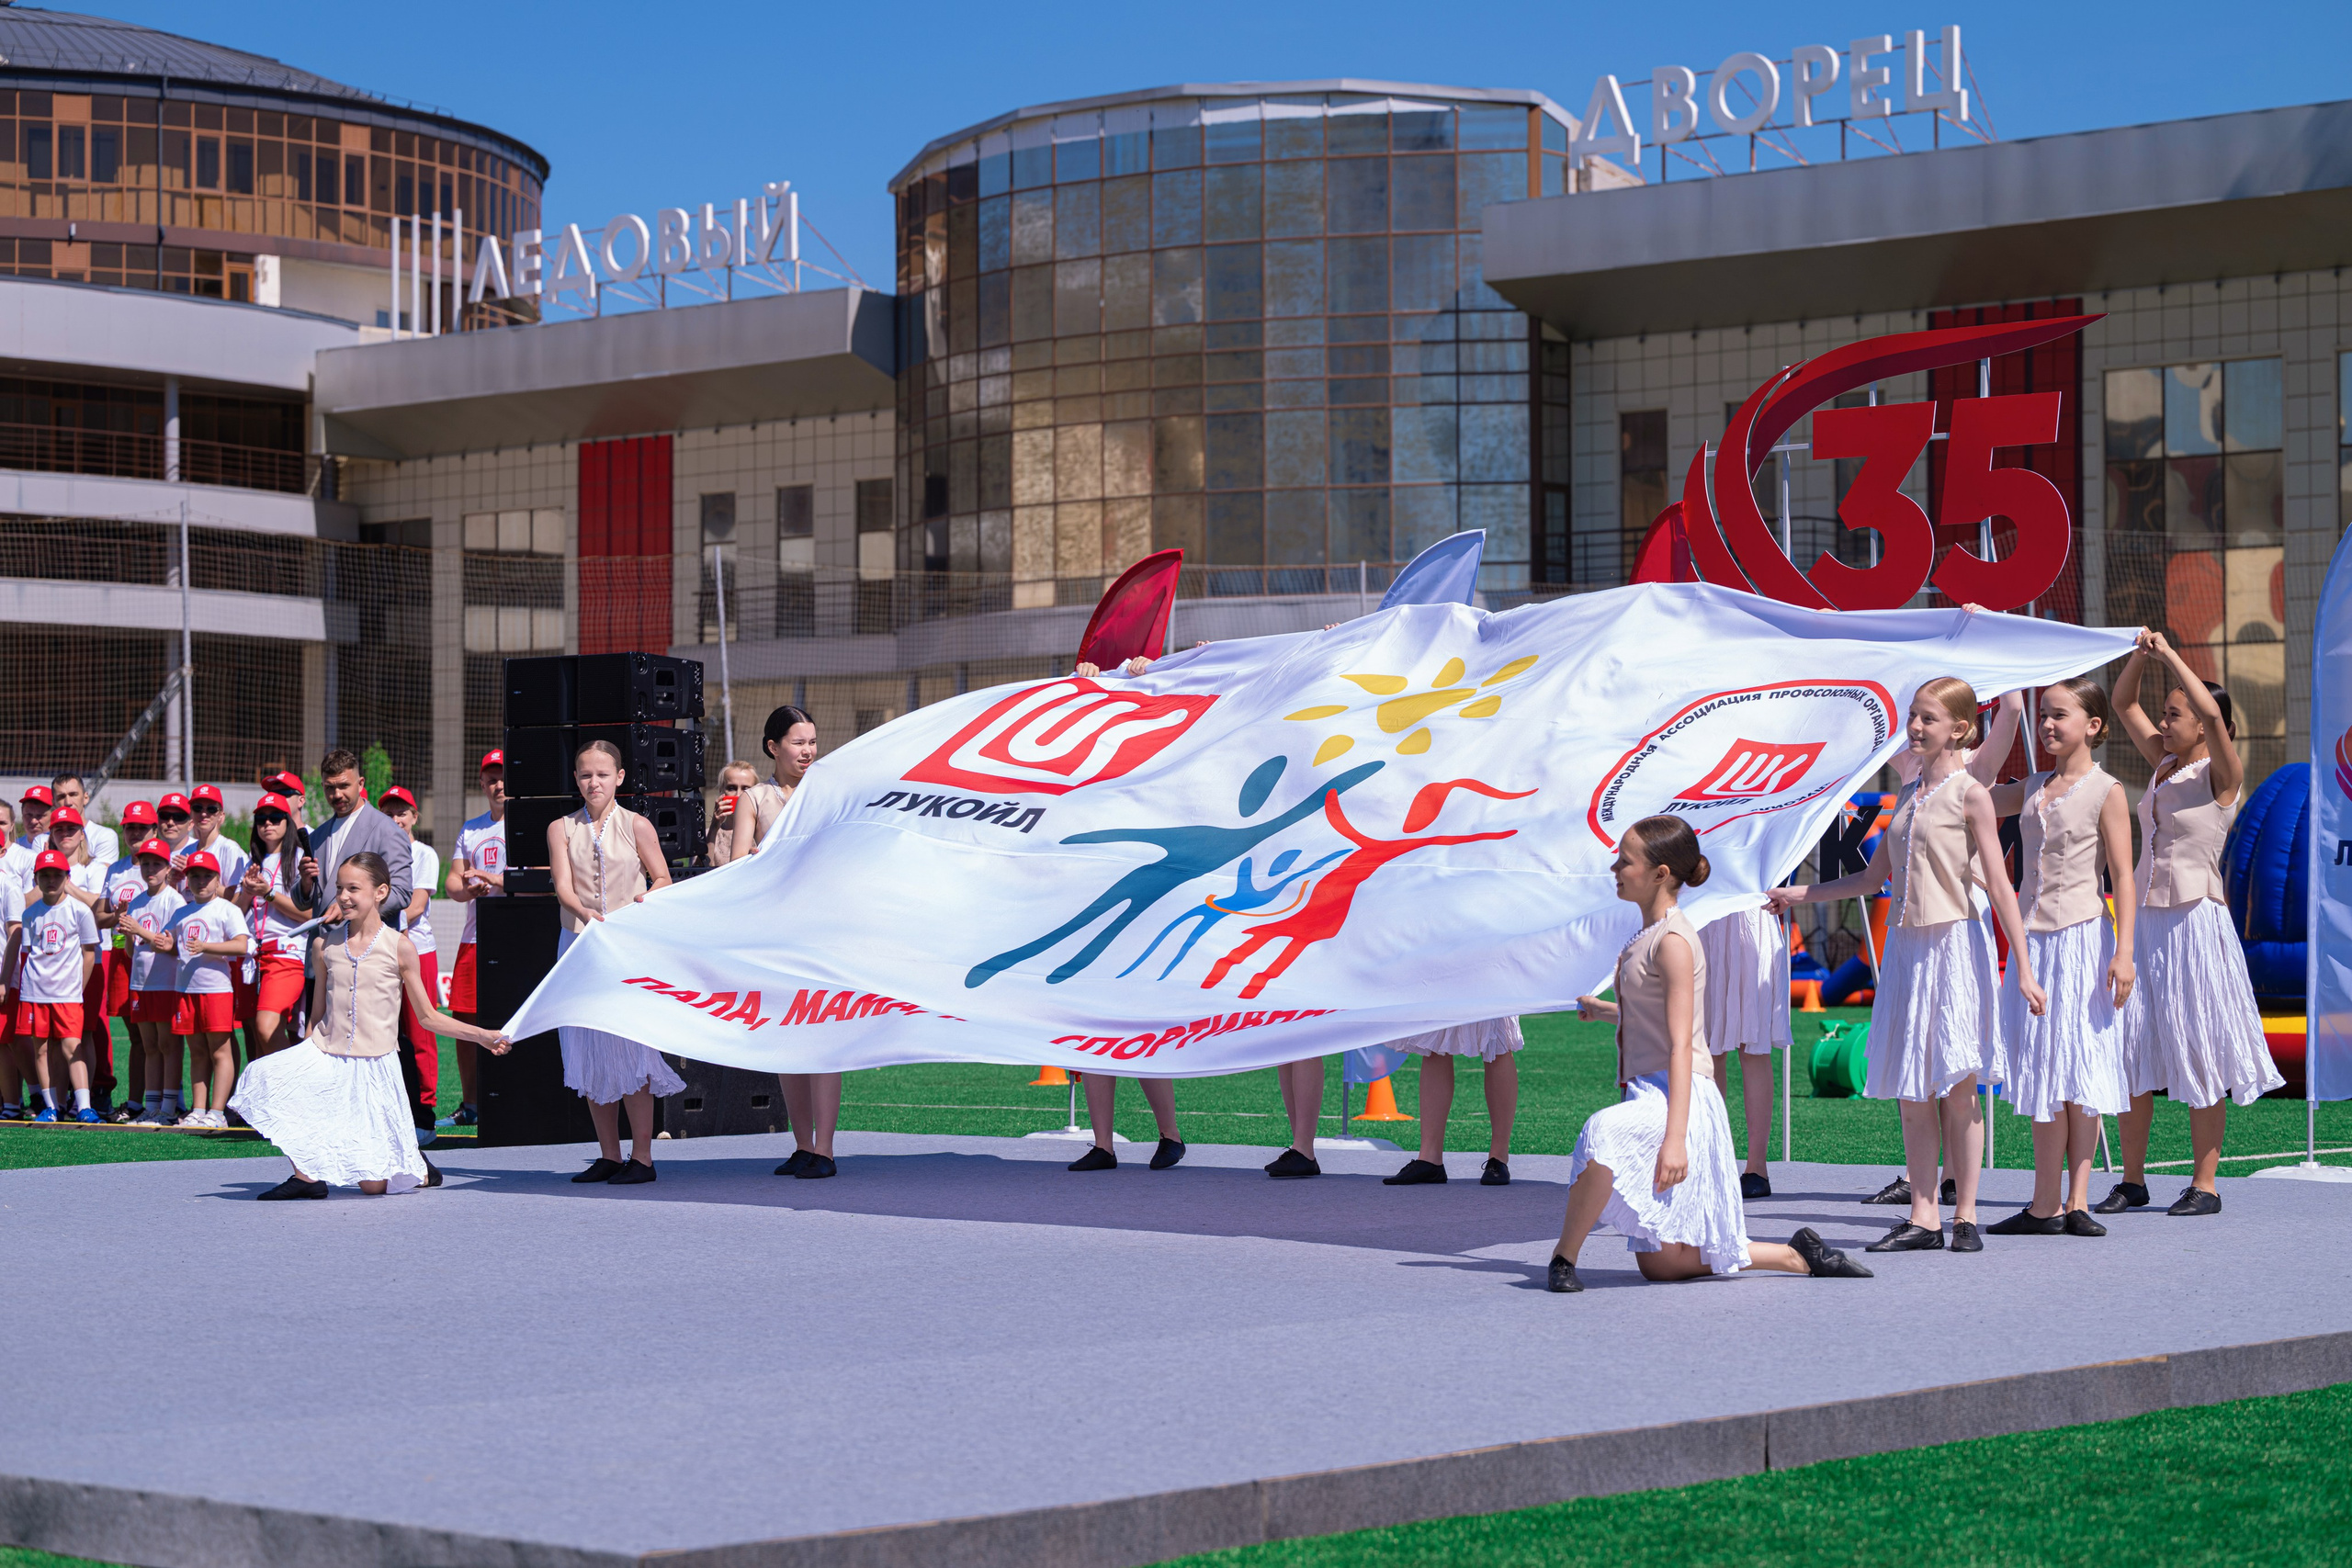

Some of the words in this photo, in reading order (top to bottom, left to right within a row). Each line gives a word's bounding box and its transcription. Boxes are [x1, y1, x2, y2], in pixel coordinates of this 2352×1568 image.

[1568, 25, 1969, 170] ДВОРЕЦ
[468, 180, 798, 303] ЛЕДОВЫЙ
[1806, 390, 2071, 613] 35
[1658, 693, 1761, 741] АССОЦИАЦИЯ
[1769, 688, 1868, 702] ПРОФСОЮЗНЫХ
[865, 791, 1047, 833] ЛУКОЙЛ
[1659, 797, 1754, 814] ЛУКОЙЛ
[1049, 1009, 1350, 1060] СПОРТИВН
